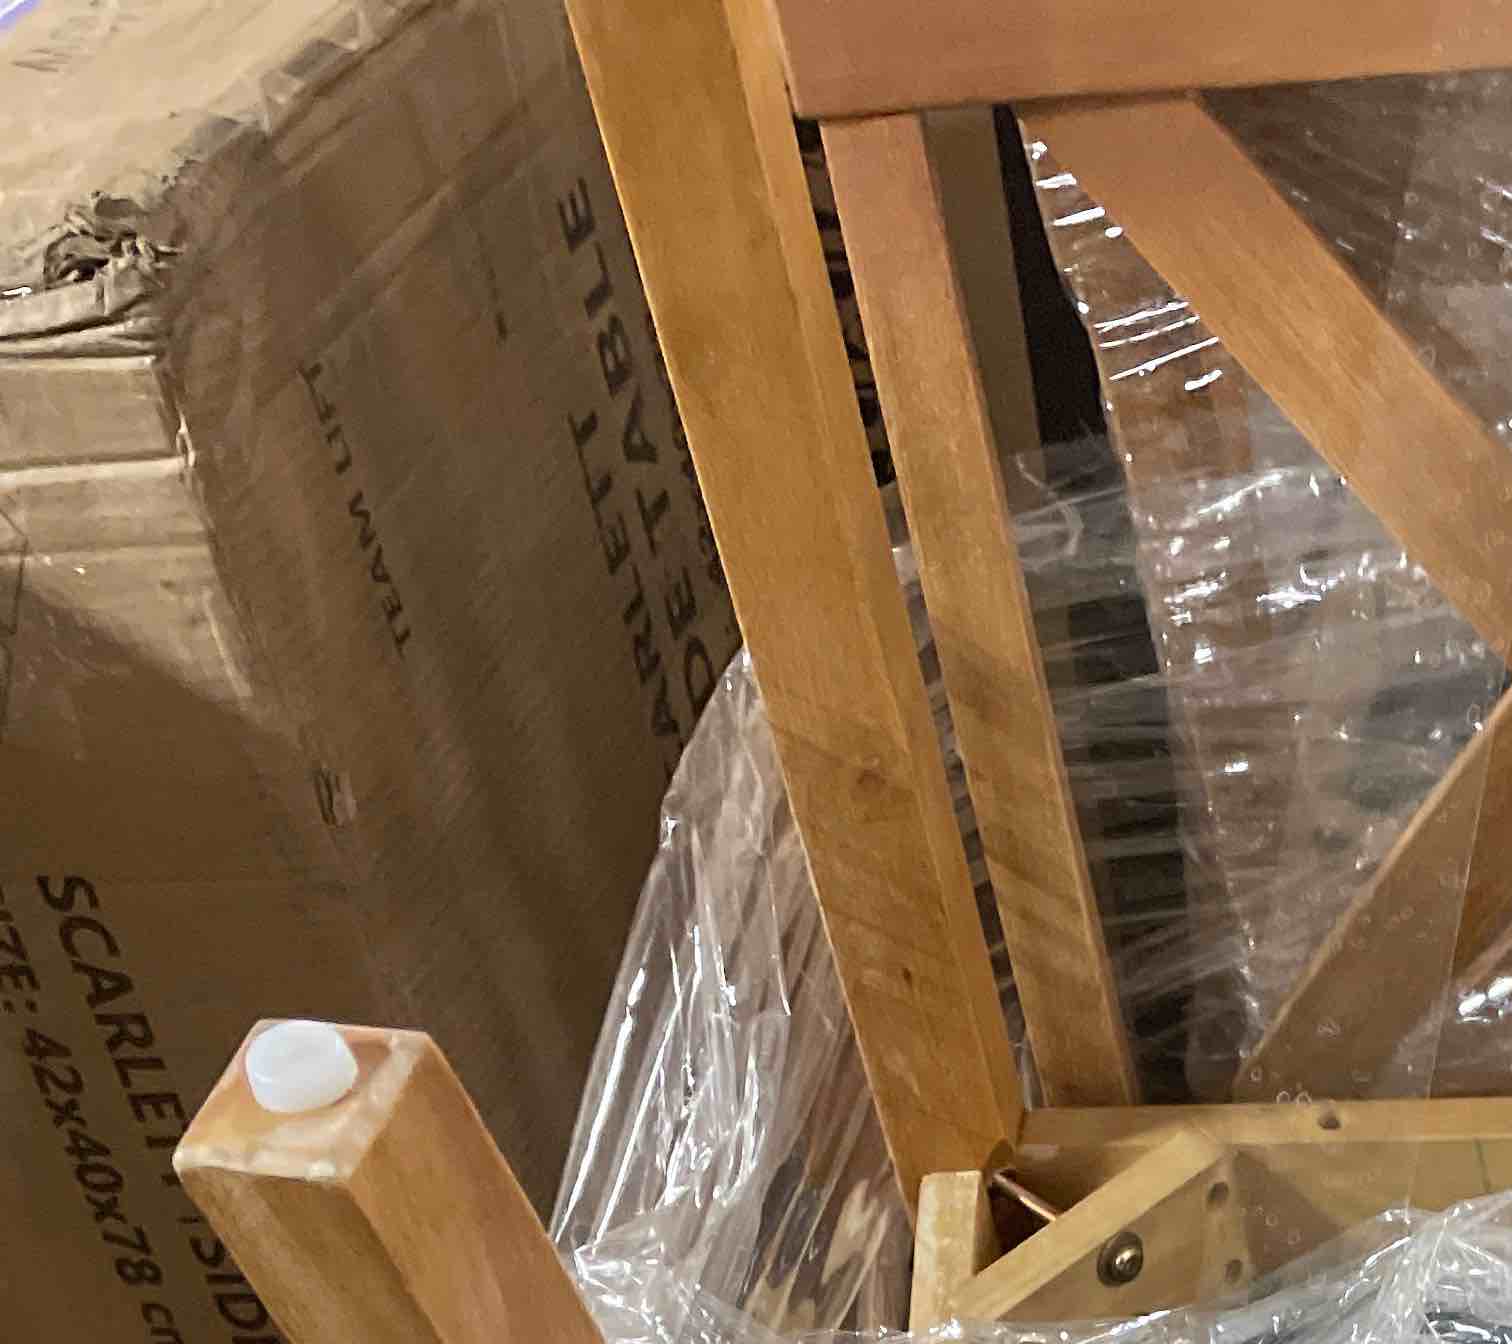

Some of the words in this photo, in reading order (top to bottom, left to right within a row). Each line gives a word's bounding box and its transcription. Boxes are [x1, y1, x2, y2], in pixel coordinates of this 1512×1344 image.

[297, 363, 352, 476] LIFT
[558, 176, 671, 556] TABLE
[349, 491, 411, 660] TEAM
[24, 1027, 164, 1287] 42x40x78
